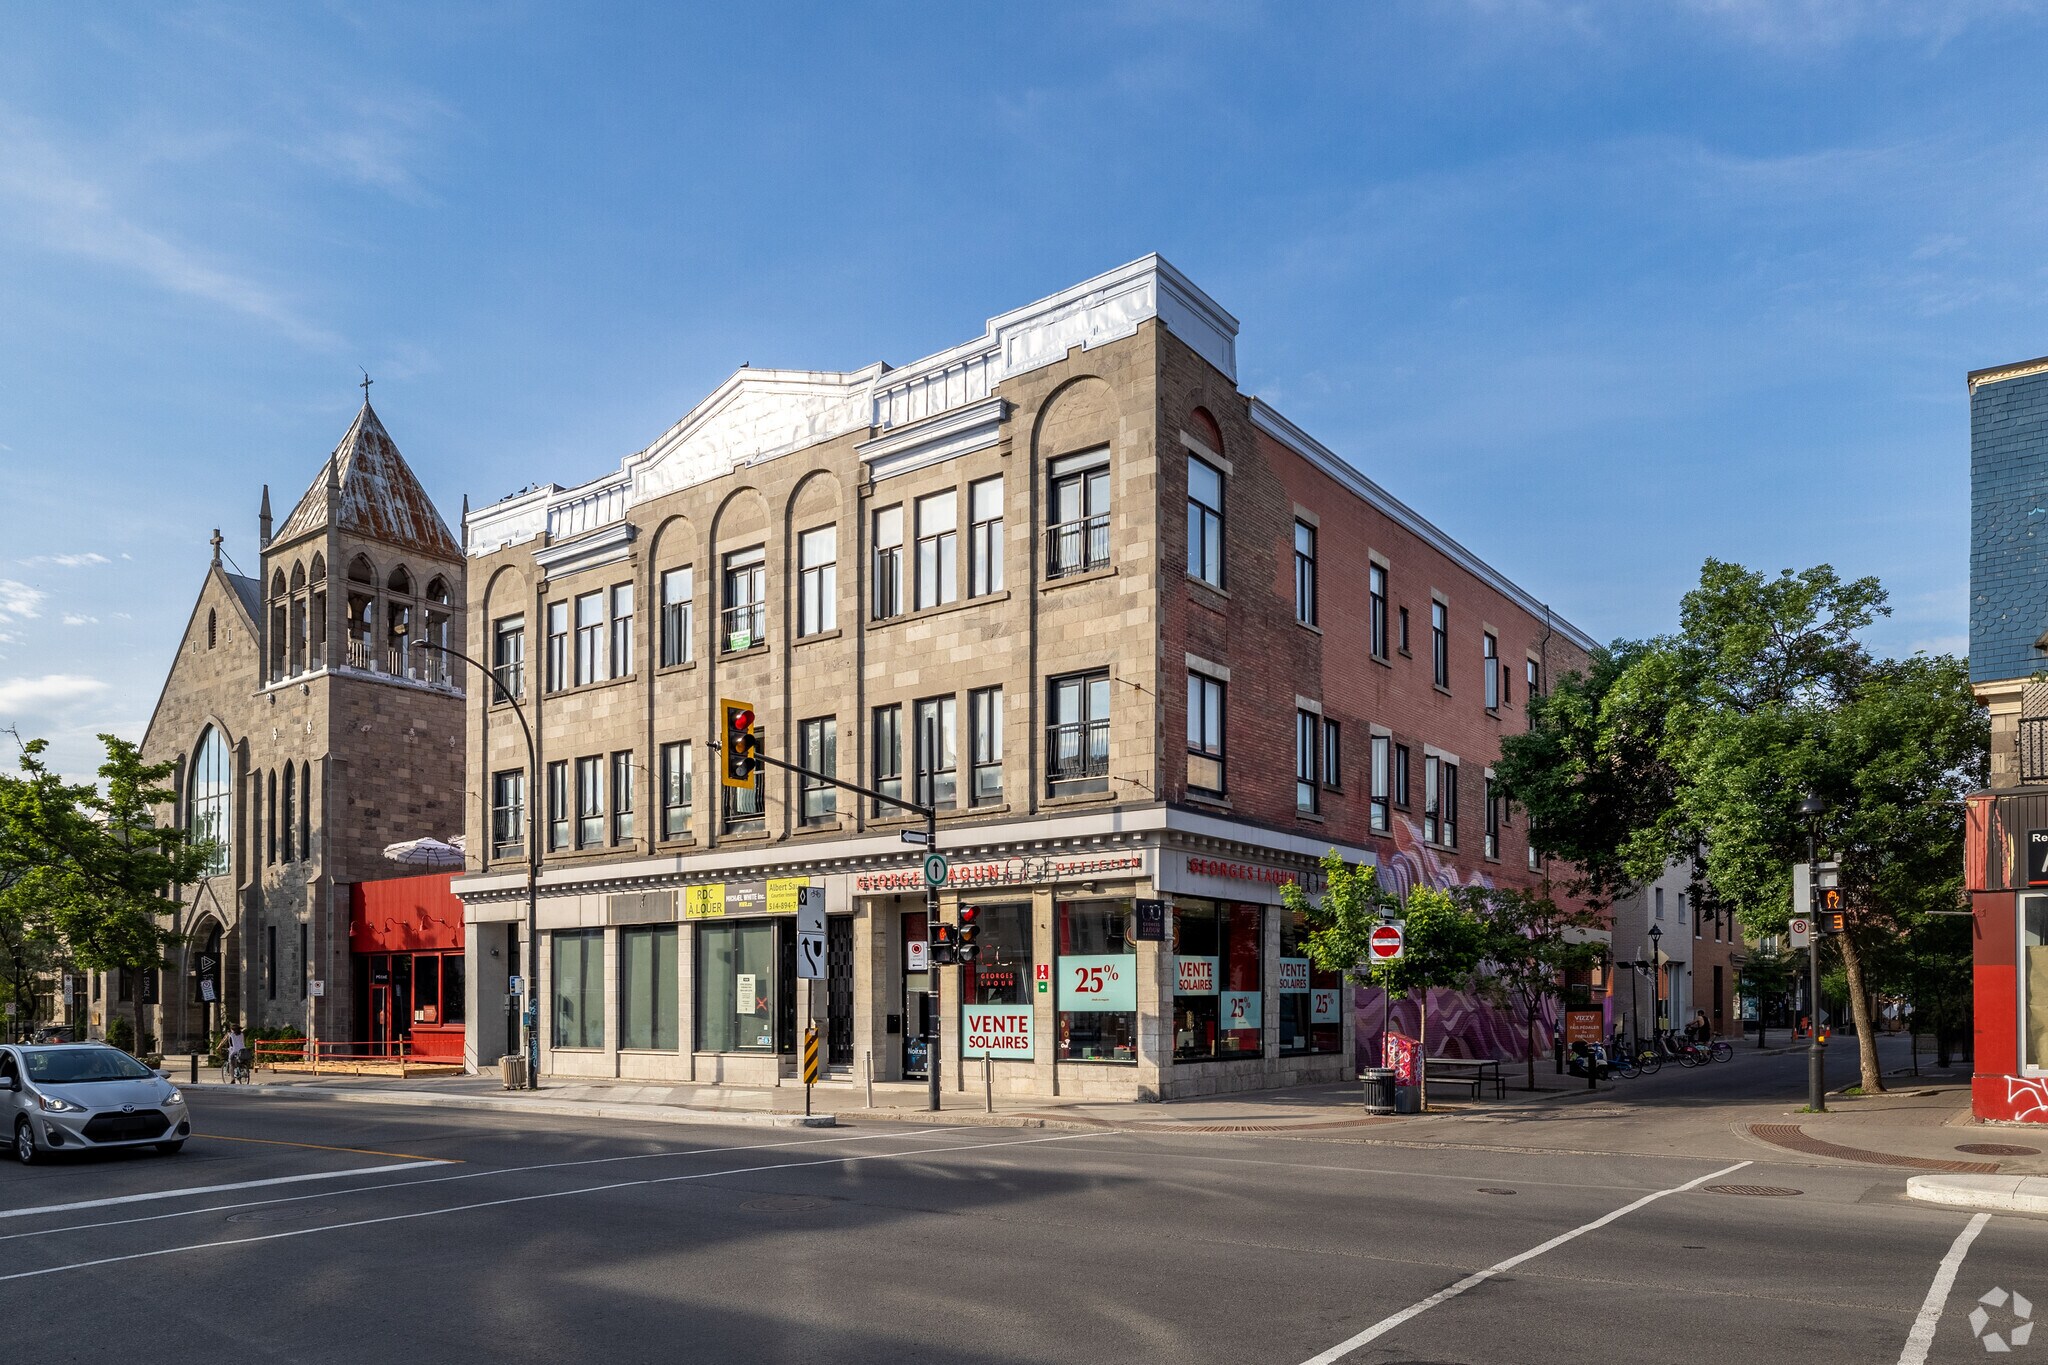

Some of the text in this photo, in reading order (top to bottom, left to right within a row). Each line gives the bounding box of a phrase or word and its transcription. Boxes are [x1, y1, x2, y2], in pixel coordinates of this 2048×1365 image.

[1056, 857, 1139, 871] OPTICIEN
[856, 864, 998, 889] GEORGE AOUN
[1190, 858, 1296, 886] GEORGES LAOUN
[697, 889, 713, 900] RDC
[769, 883, 787, 892] Albert
[688, 901, 722, 914] À LOUER
[769, 902, 798, 912] 514-894-7
[1179, 962, 1212, 977] VENTE
[1280, 963, 1307, 977] VENTE
[1075, 964, 1119, 993] 25%
[1179, 979, 1213, 990] SOLAIRES
[1280, 979, 1307, 988] SOLAIRES
[1231, 996, 1252, 1018] 25%
[1315, 993, 1335, 1014] 25%
[969, 1015, 1029, 1033] VENTE
[969, 1035, 1029, 1049] SOLAIRES
